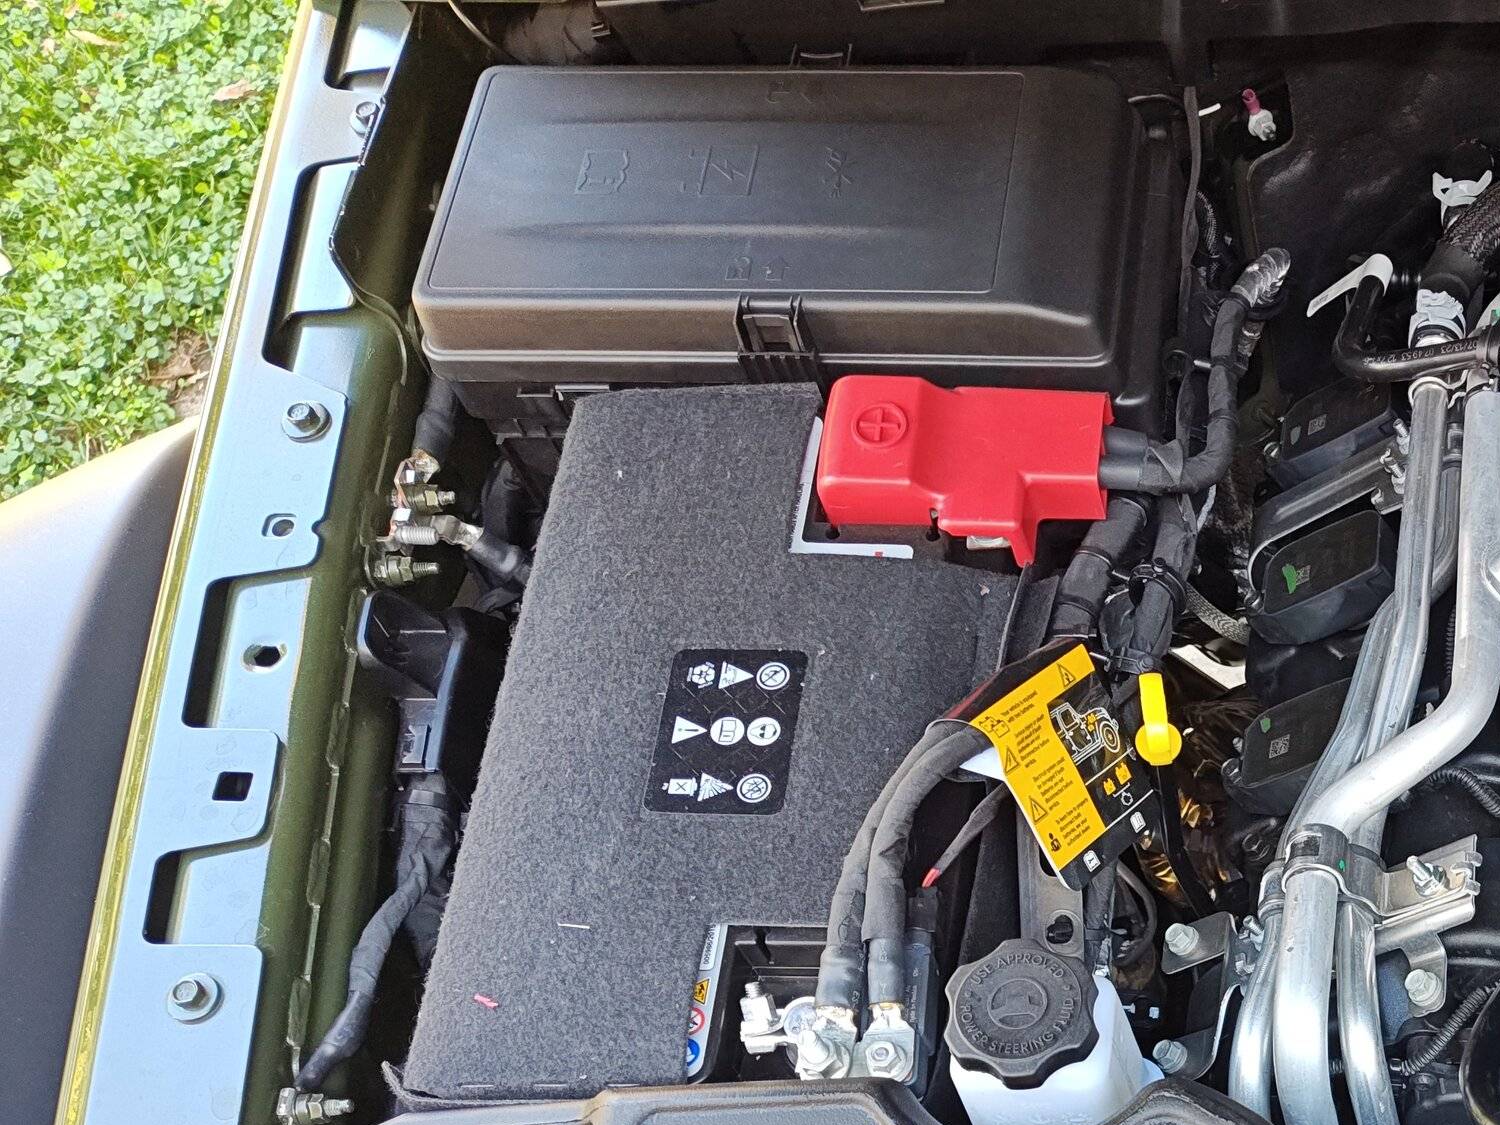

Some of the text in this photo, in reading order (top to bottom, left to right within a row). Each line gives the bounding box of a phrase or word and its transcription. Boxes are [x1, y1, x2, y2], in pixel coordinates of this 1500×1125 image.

[970, 952, 1065, 985] USE APPROVED
[959, 999, 1075, 1055] POWER STEERING FLUID
